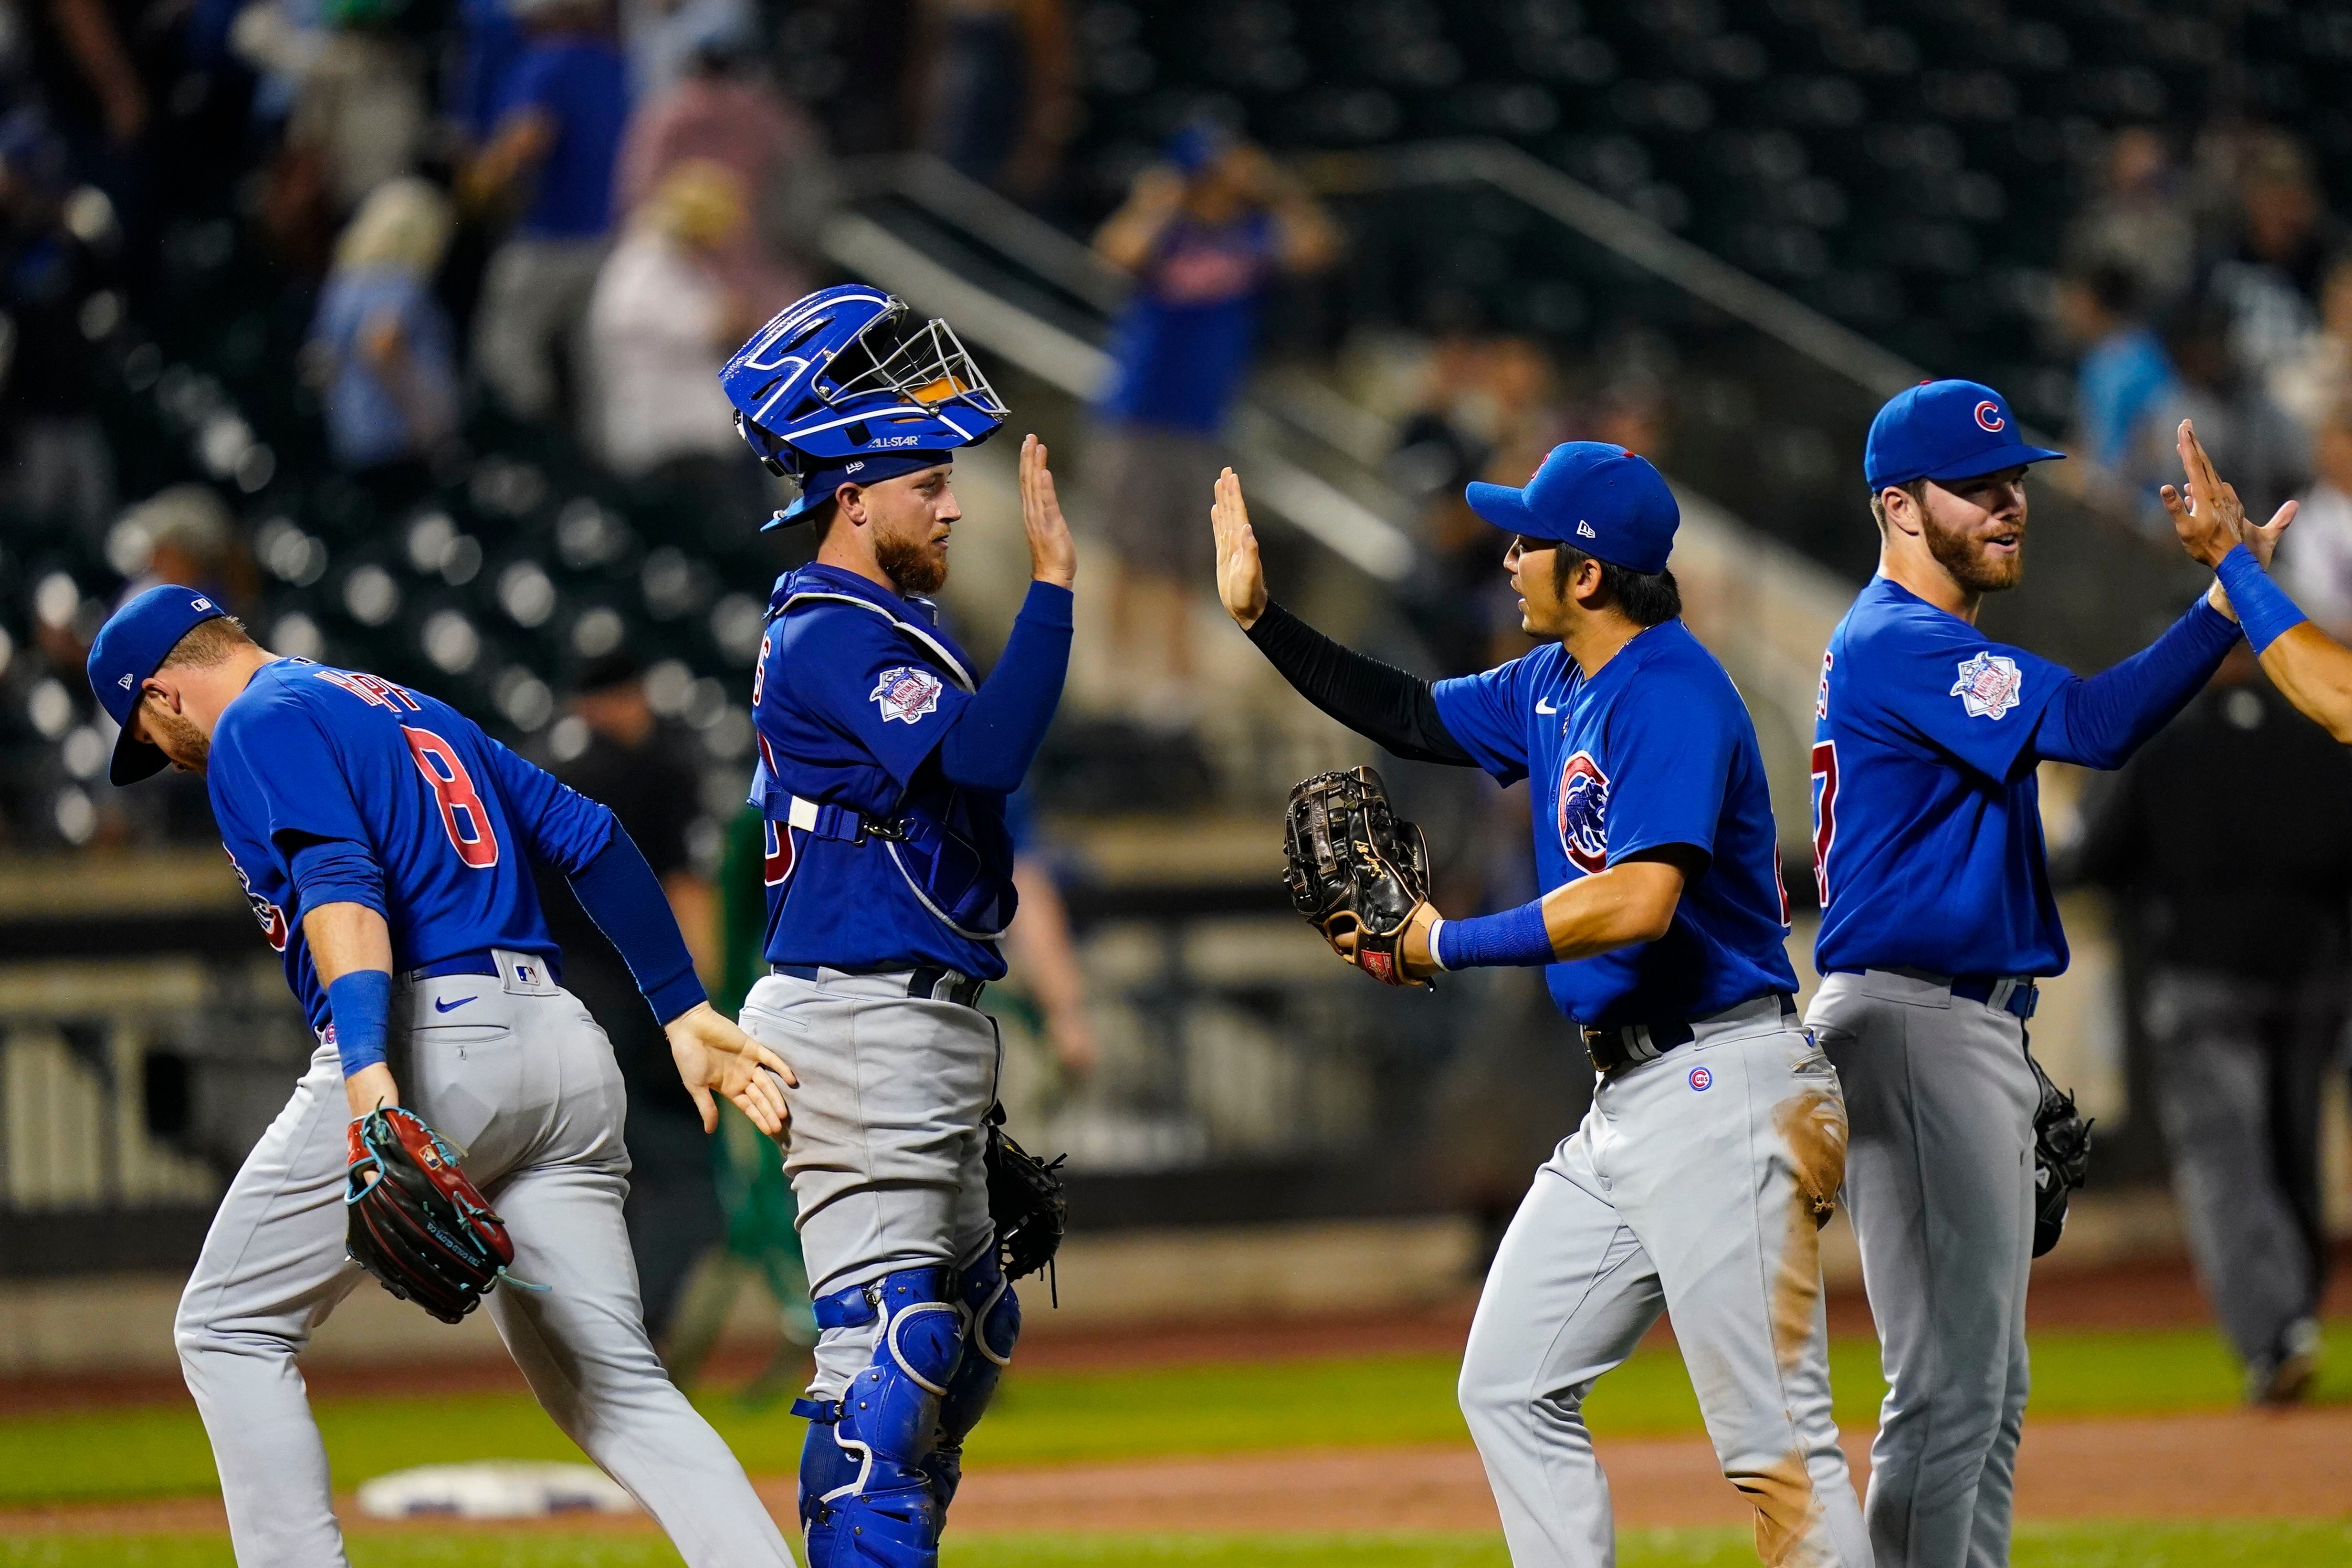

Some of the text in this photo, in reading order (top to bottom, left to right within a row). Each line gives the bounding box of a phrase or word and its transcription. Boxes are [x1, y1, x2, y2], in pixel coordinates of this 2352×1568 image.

[1974, 400, 2005, 432] C
[867, 435, 919, 449] ALL-STAR
[400, 724, 499, 868] 8
